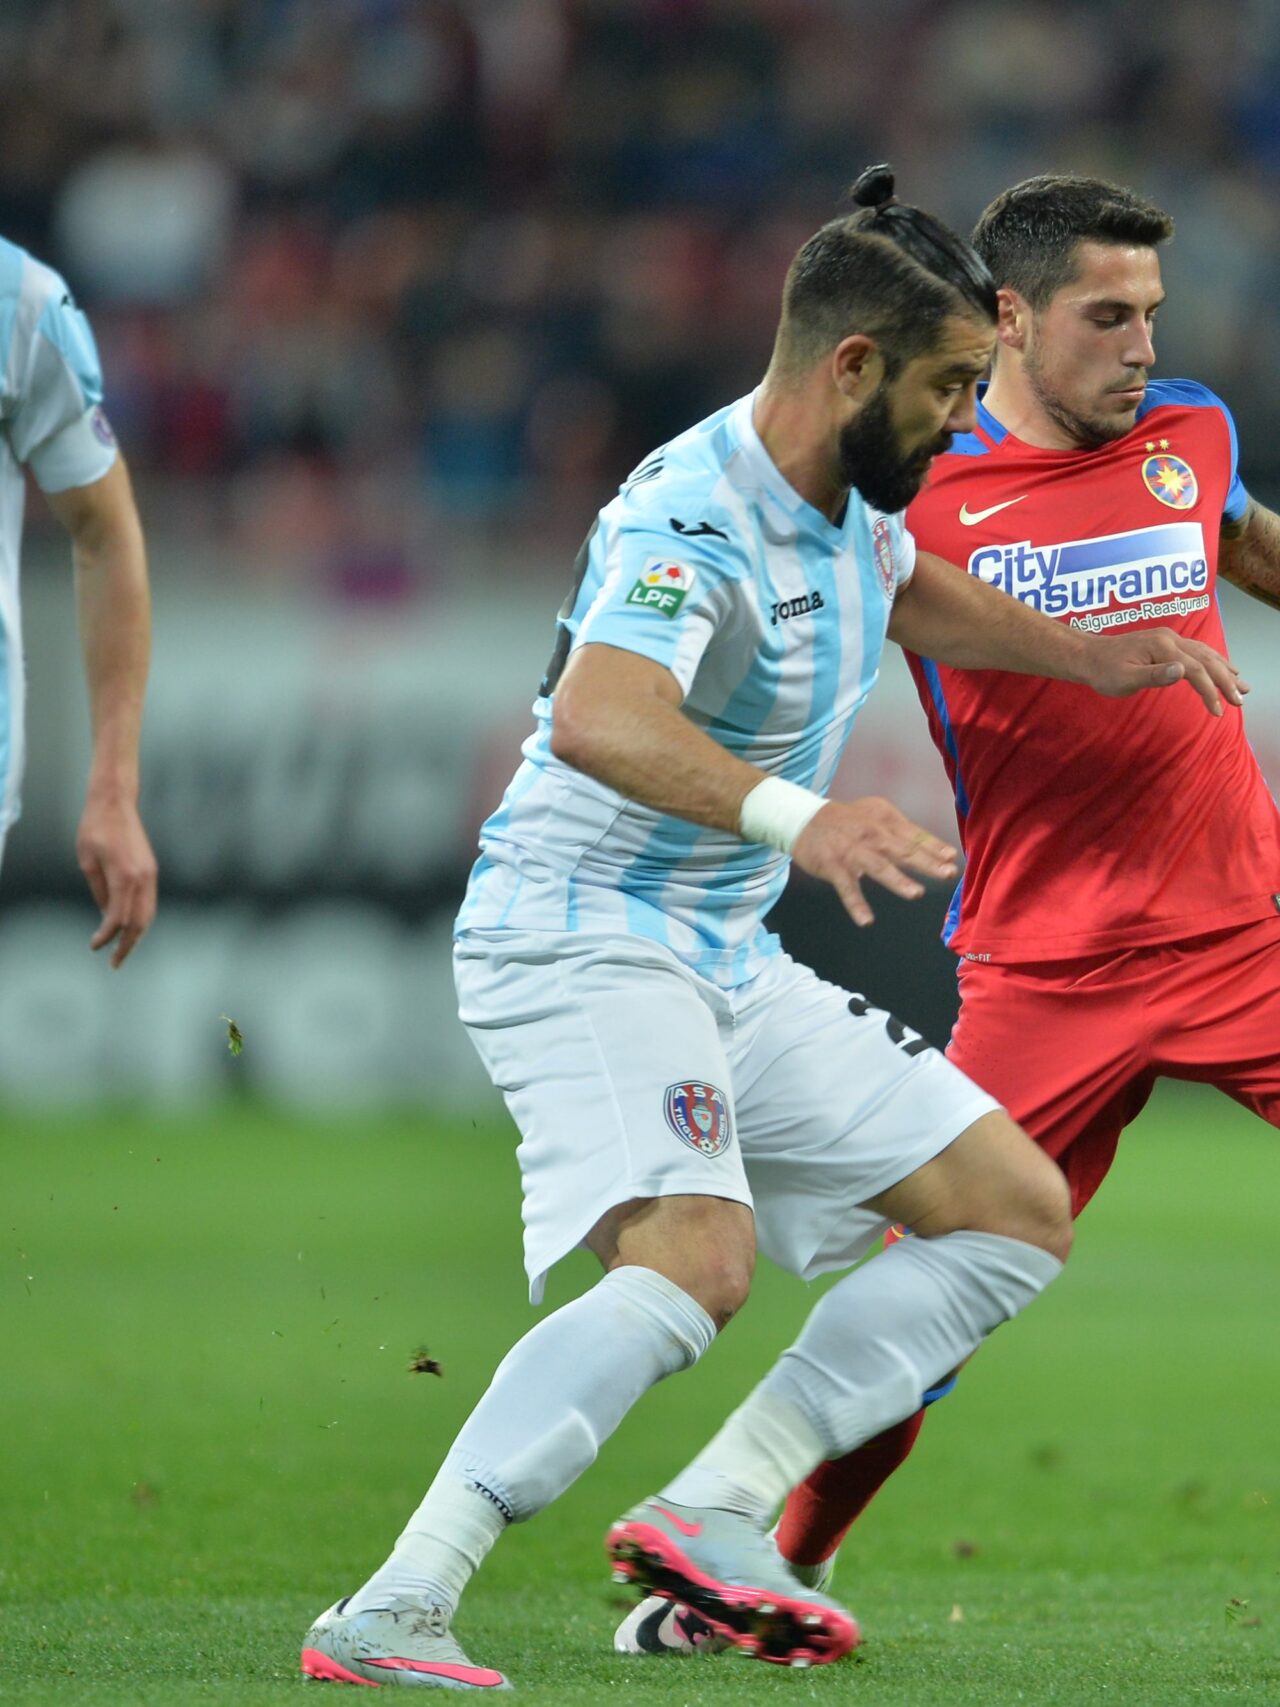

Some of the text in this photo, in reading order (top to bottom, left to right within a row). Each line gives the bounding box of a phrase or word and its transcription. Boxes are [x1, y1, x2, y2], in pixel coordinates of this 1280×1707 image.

[972, 547, 1058, 590] City
[631, 587, 677, 609] LPF
[1071, 595, 1209, 630] Asigurare-Reasigurare
[674, 1086, 721, 1104] ASA
